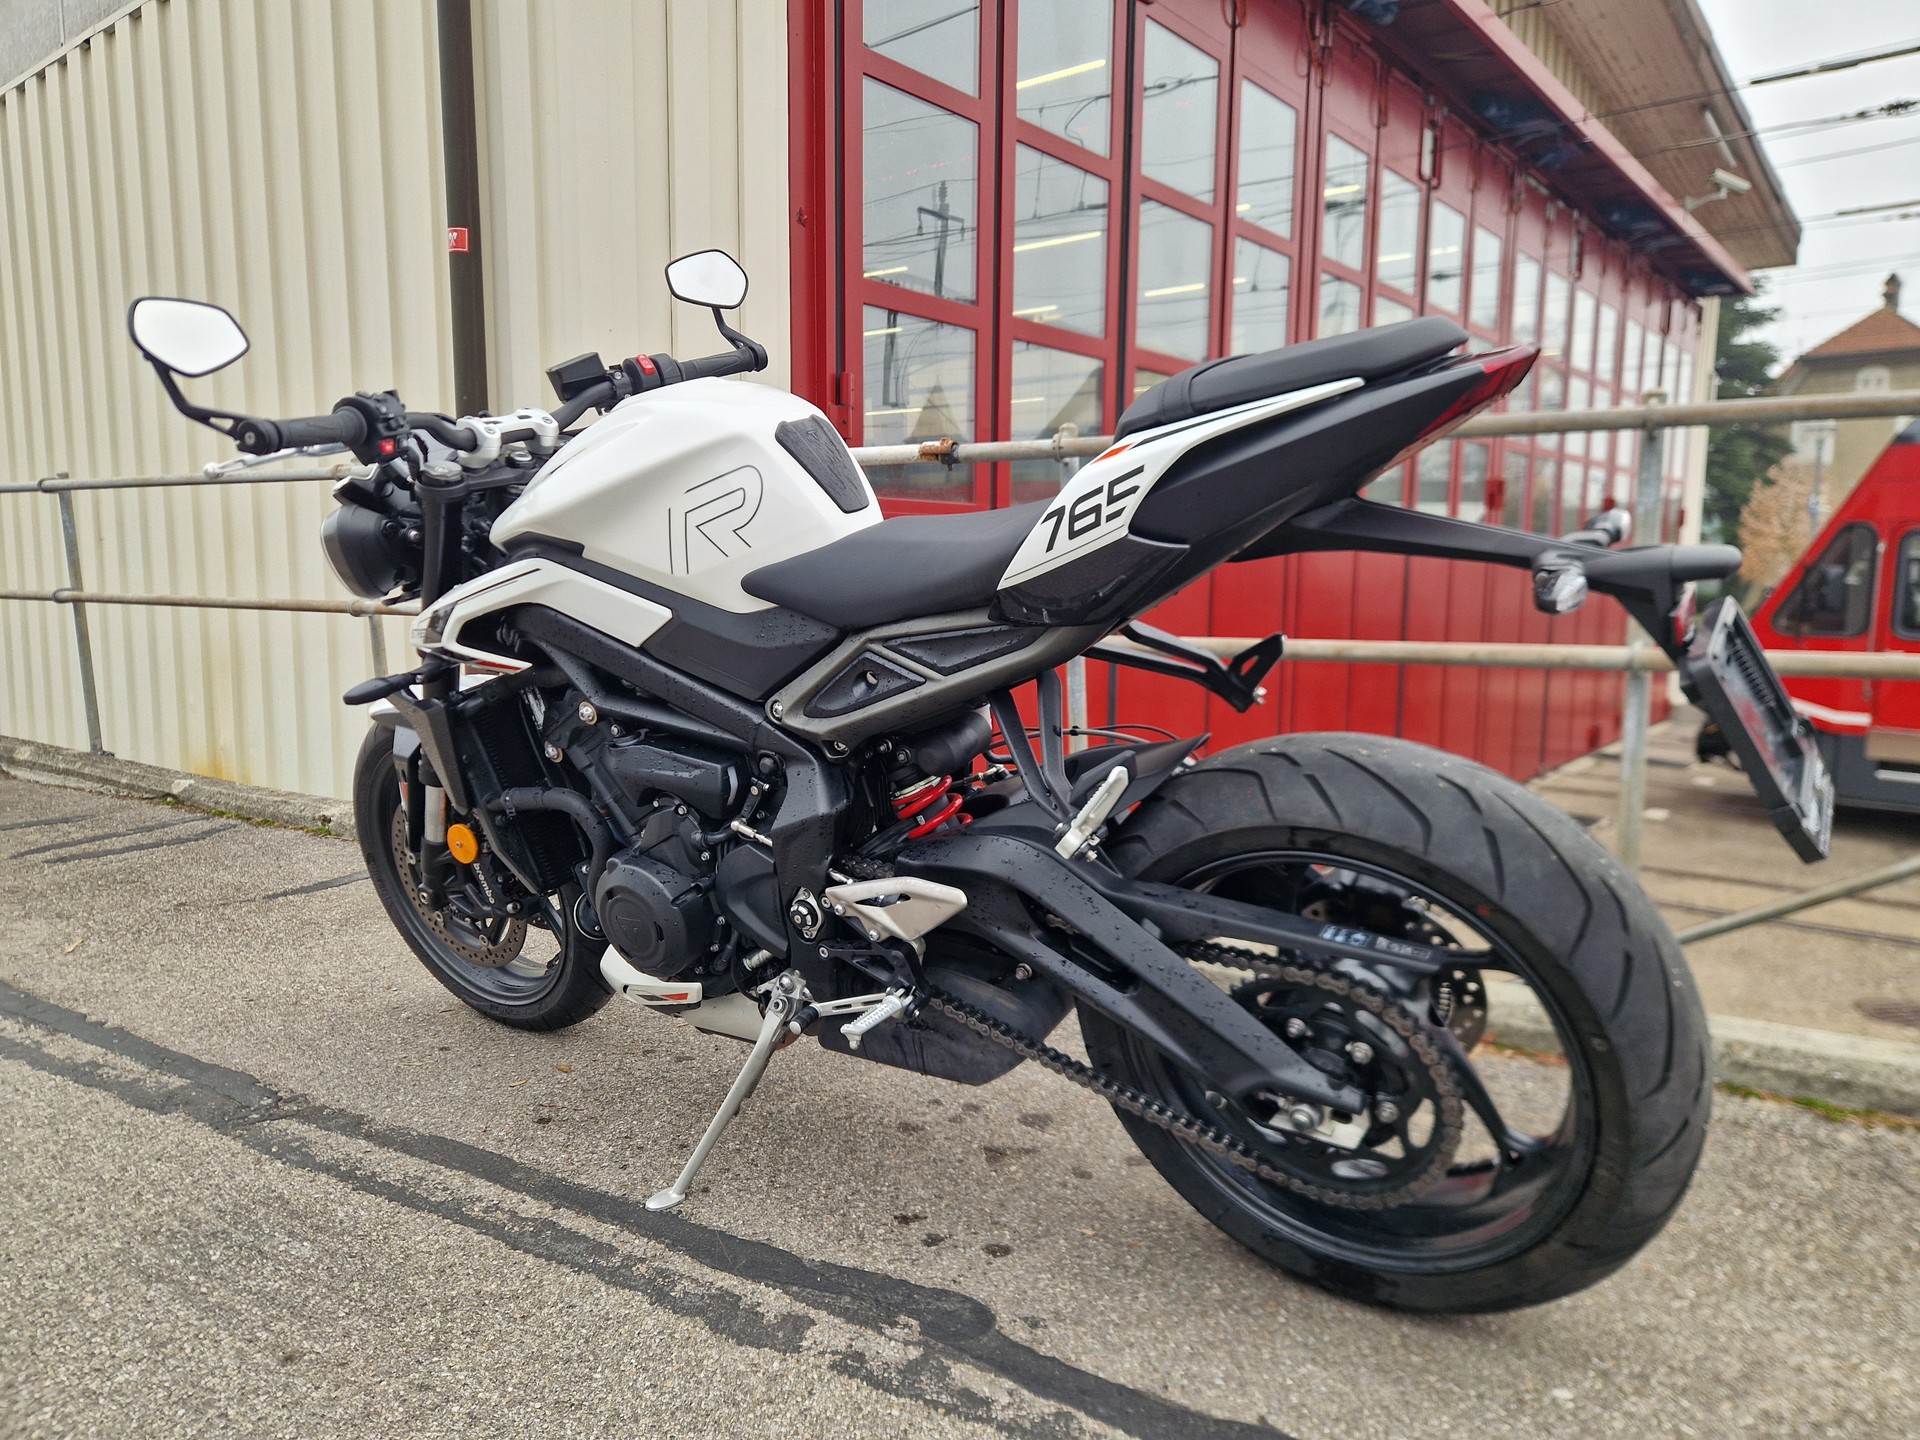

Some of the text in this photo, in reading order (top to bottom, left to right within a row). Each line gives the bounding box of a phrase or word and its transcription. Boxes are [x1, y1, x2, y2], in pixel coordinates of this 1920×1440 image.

[668, 464, 763, 575] R
[1041, 464, 1145, 553] 765
[473, 862, 495, 904] brembo
